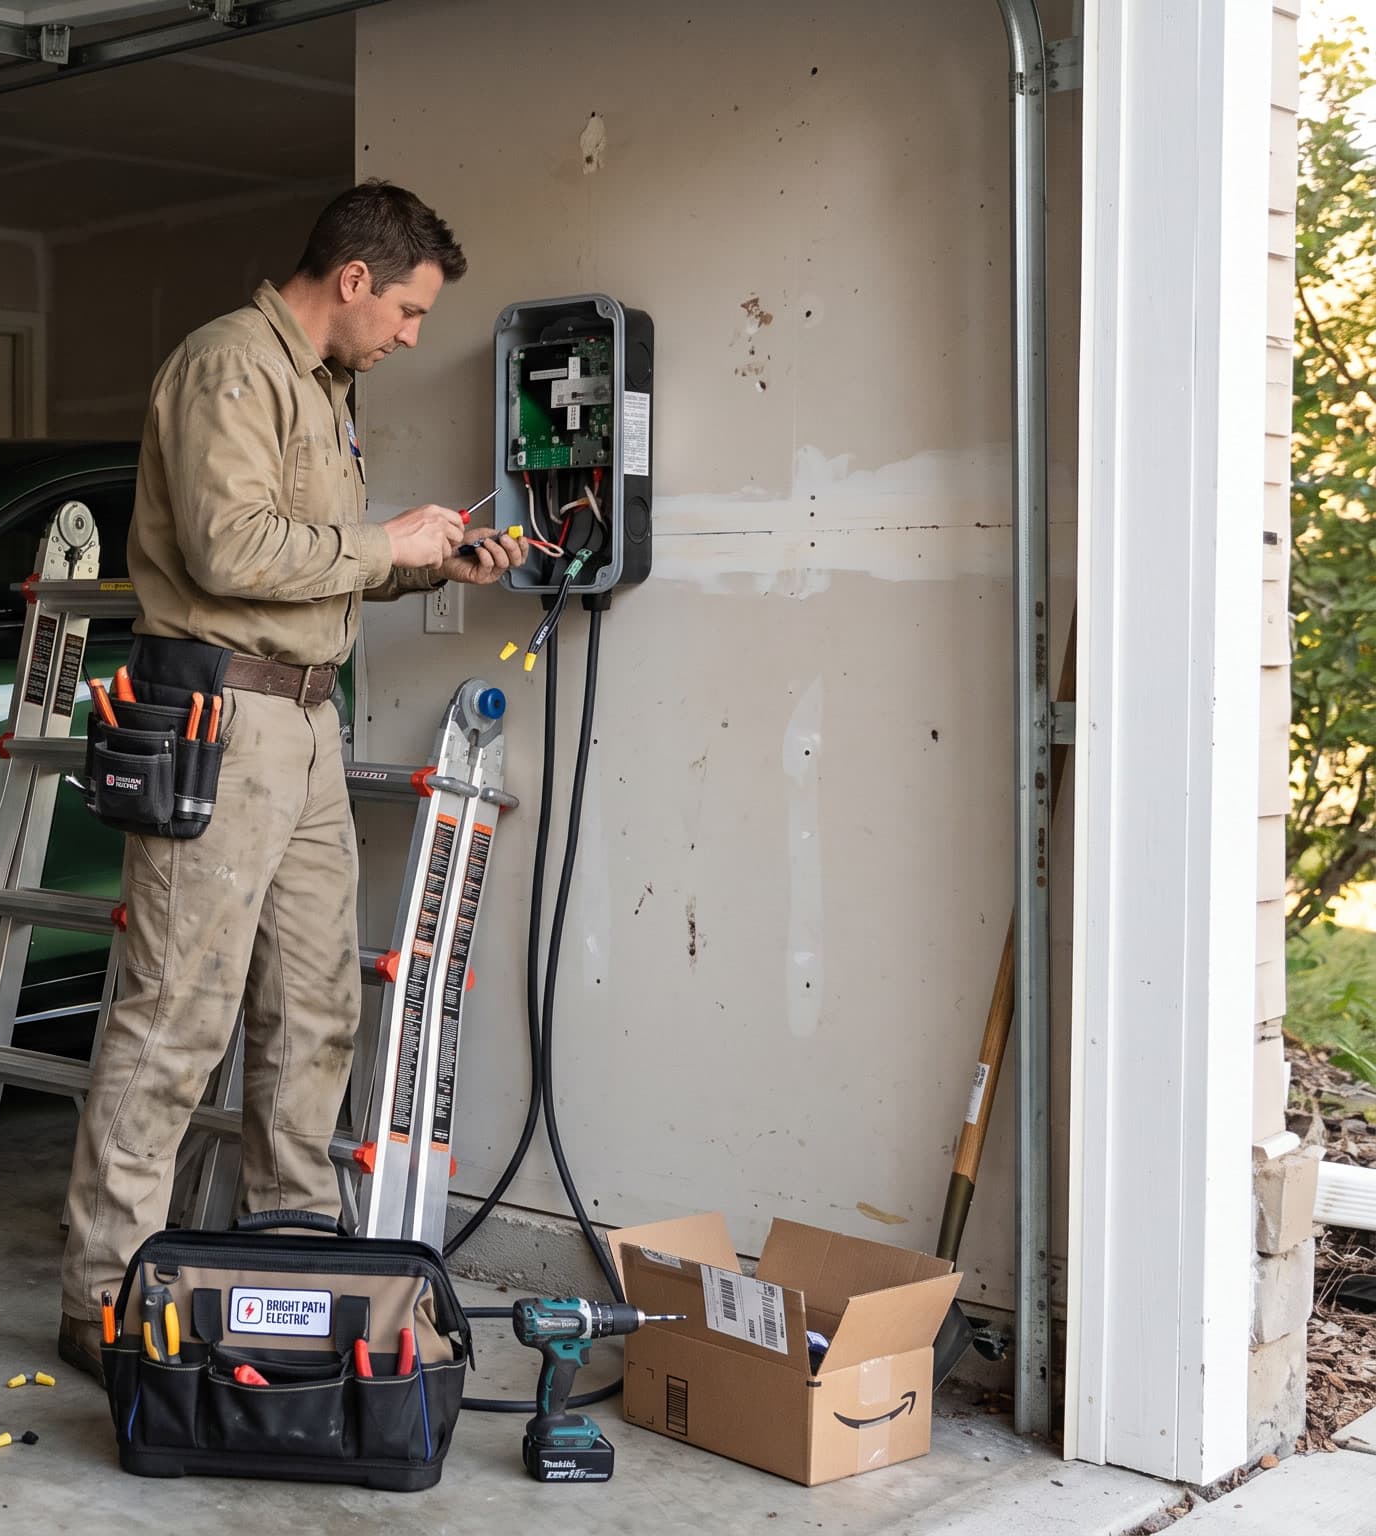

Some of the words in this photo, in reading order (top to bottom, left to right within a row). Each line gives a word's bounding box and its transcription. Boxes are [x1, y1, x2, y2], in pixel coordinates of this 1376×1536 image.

[266, 1299, 300, 1312] BRIGHT
[302, 1301, 326, 1313] PATH
[266, 1312, 309, 1325] ELECTRIC
